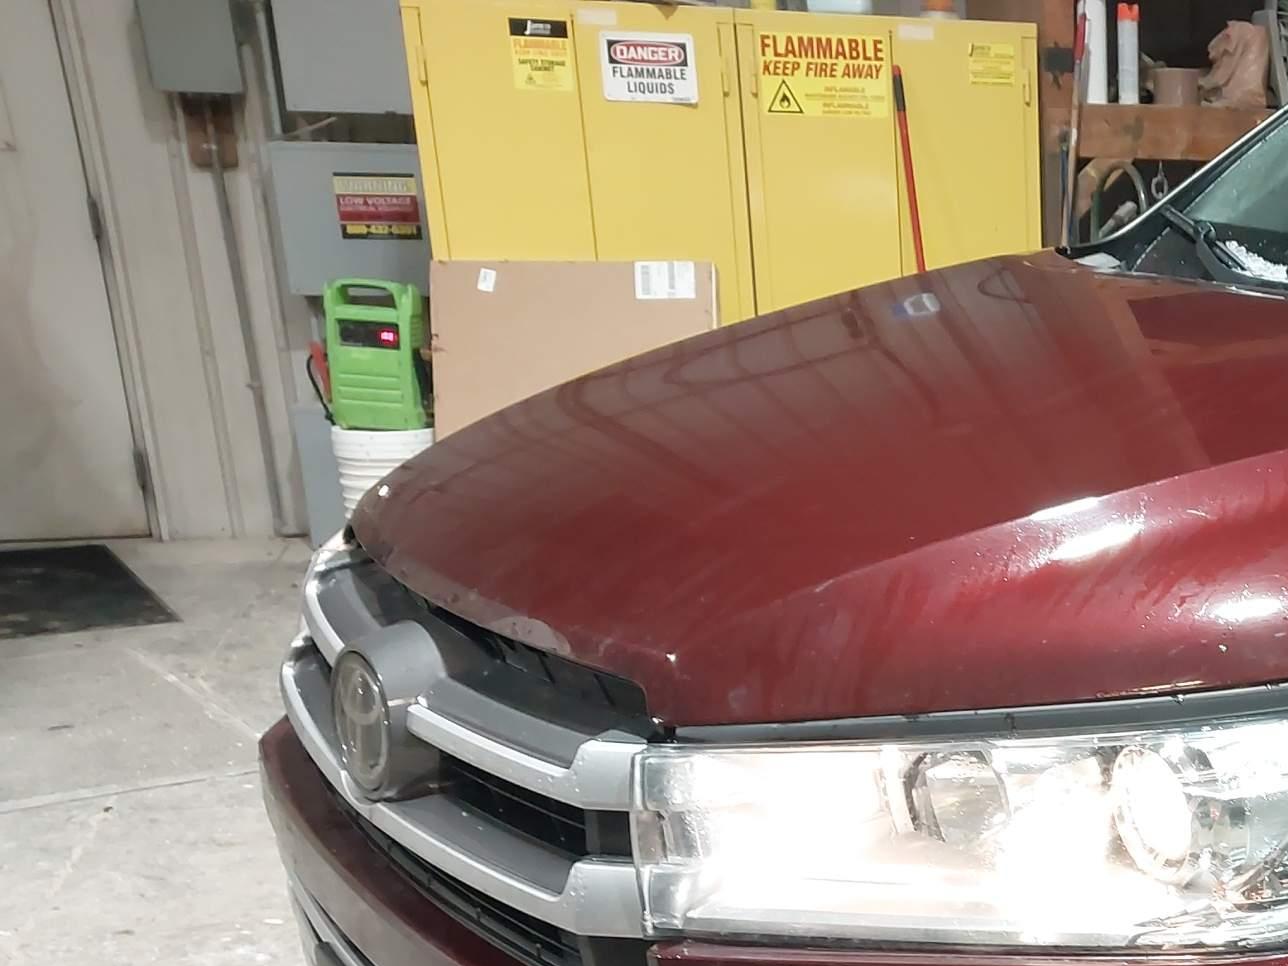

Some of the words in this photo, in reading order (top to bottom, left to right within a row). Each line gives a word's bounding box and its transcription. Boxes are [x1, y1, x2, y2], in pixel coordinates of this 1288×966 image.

[615, 45, 679, 61] DANGER
[760, 34, 884, 62] FLAMMABLE
[612, 66, 687, 80] FLAMMABLE
[762, 60, 800, 76] KEEP
[805, 62, 838, 78] FIRE
[841, 63, 883, 80] AWAY
[627, 81, 675, 95] LIQUIDS
